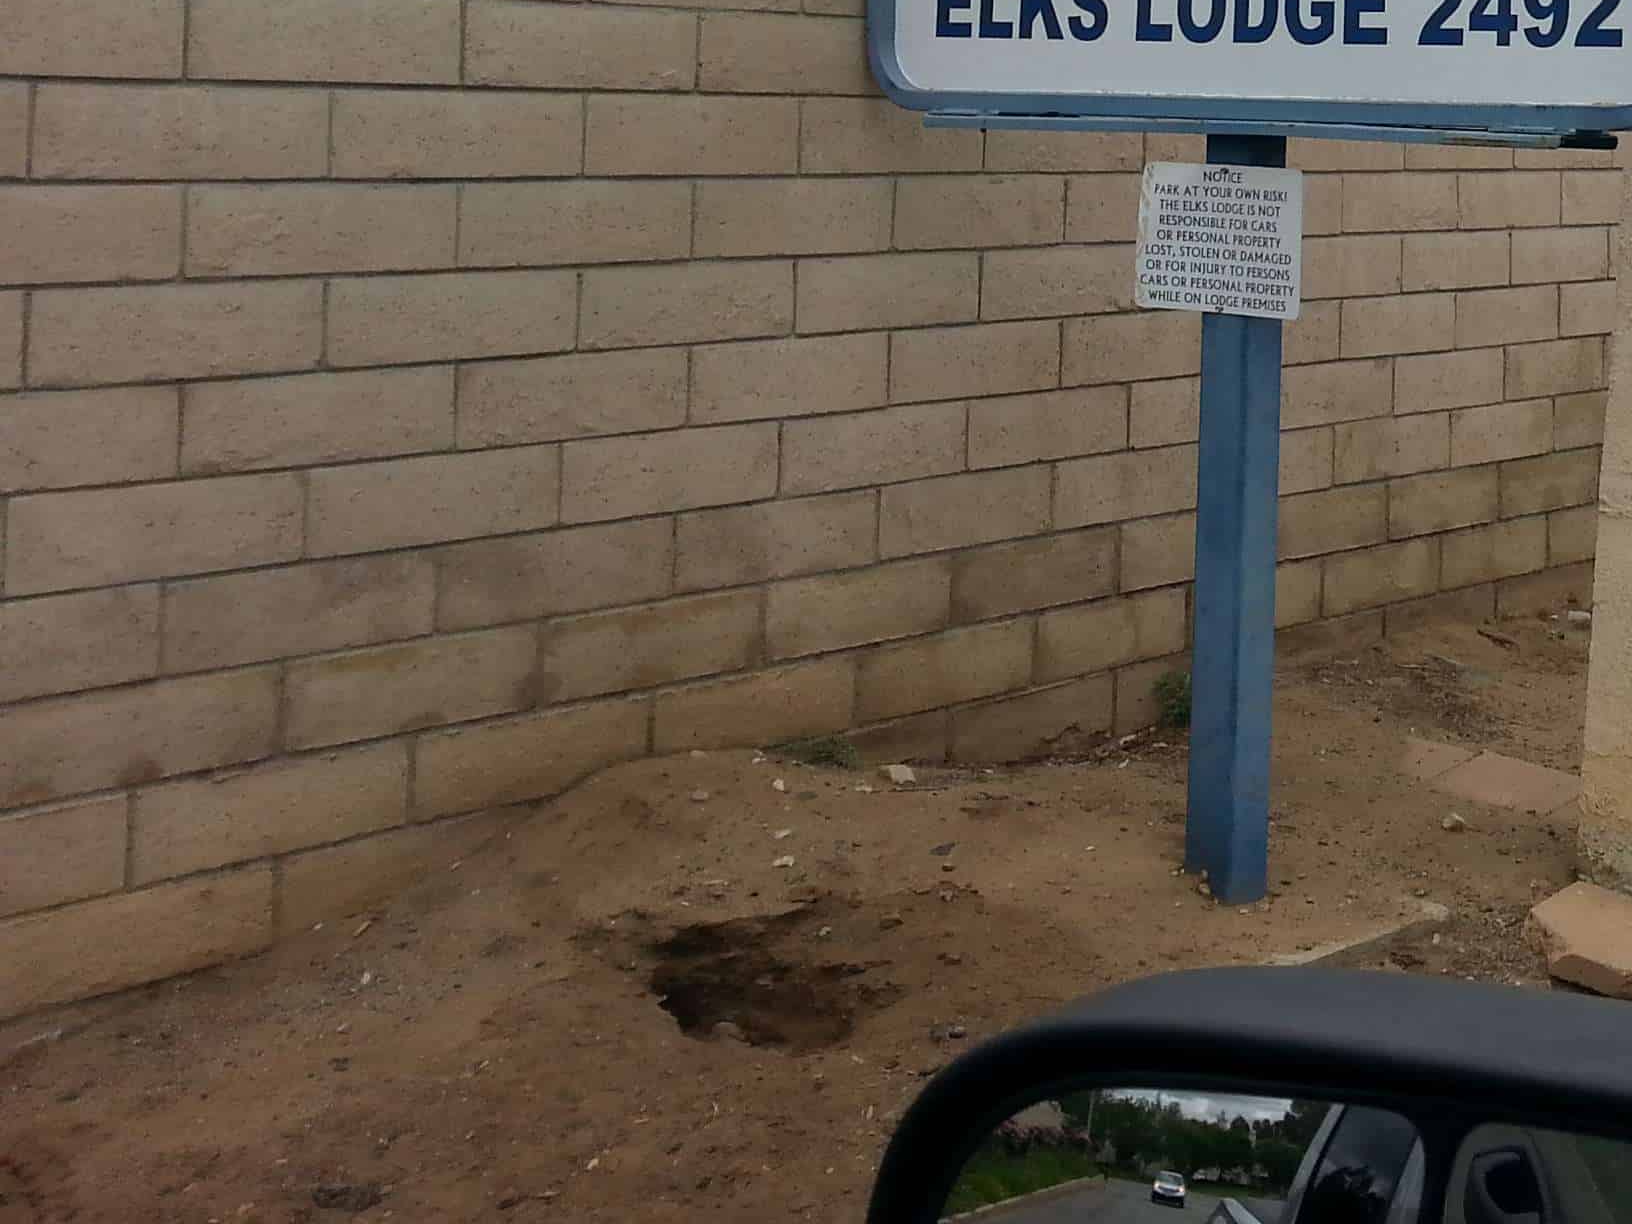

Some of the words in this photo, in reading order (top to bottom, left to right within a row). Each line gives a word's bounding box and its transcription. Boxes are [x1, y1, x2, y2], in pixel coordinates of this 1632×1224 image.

[1203, 170, 1243, 184] NOTICE
[1154, 184, 1179, 196] PARK
[1183, 185, 1200, 197] AT
[1203, 186, 1231, 198] YOUR
[1235, 188, 1260, 200] OWN
[1263, 190, 1288, 202] RISK!
[1160, 199, 1179, 211] THE
[1183, 200, 1208, 213] ELKS
[1212, 202, 1244, 215] LODGE
[1247, 204, 1255, 216] IS
[1258, 206, 1281, 217] NOT
[1159, 215, 1227, 229] RESPONSIBLE
[1229, 218, 1248, 230] FOR
[1251, 221, 1277, 233] CARS
[1157, 229, 1172, 241] OR
[1176, 231, 1230, 246] PERSONAL
[1233, 235, 1281, 249] PROPERTY
[1145, 245, 1176, 258] LOST,
[1179, 246, 1220, 260] STOLEN
[1223, 249, 1237, 261] OR
[1240, 250, 1292, 265] DAMAGED
[1146, 259, 1162, 271] OR
[1165, 260, 1186, 272] FOR
[1190, 262, 1226, 276] INJURY
[1230, 265, 1244, 277] TO
[1246, 266, 1290, 281] PERSONS
[1140, 274, 1168, 286] CARS
[1171, 275, 1187, 287] OR
[1190, 277, 1243, 293] PERSONAL
[1245, 281, 1295, 297] PROPERTY
[1149, 290, 1180, 303] WHILE
[1184, 291, 1201, 304] ON
[1205, 293, 1238, 308] LODGE
[1241, 296, 1287, 312] PREMISES
